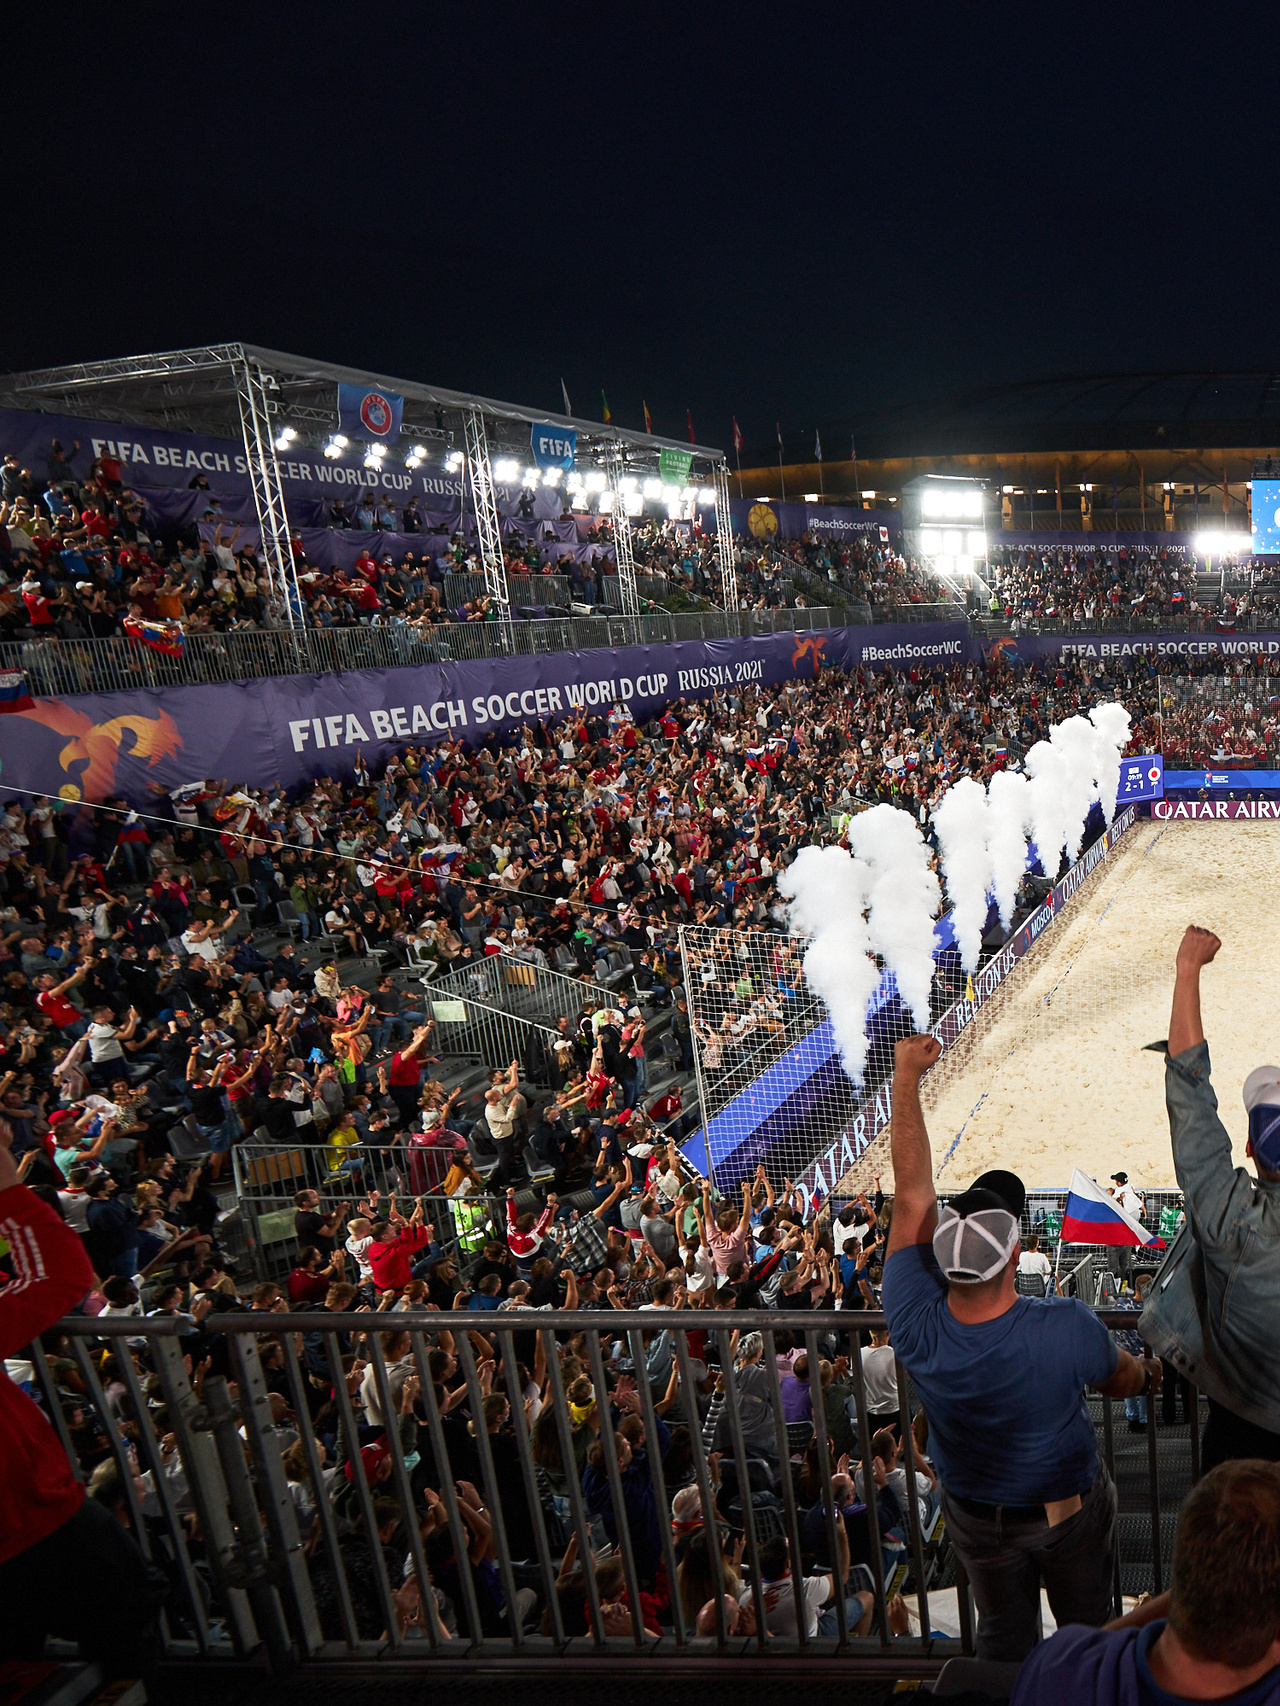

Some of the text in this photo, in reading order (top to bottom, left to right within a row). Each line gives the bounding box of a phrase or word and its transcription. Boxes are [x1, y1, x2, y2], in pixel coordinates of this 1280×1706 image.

[539, 437, 573, 458] FIFA
[91, 438, 150, 465] FIFA
[152, 445, 231, 473] BEACH
[315, 465, 378, 488] WORLD
[382, 473, 413, 491] CUP
[809, 518, 878, 531] #BeachSoccerWC
[1038, 544, 1073, 552] SOCCER
[1074, 544, 1107, 553] WORD
[862, 640, 962, 661] #BeachSoccerWC
[1061, 643, 1097, 657] FIFA
[1100, 643, 1153, 657] BEACH
[1157, 642, 1218, 655] SOCCER
[1221, 641, 1279, 655] WORLD
[289, 712, 370, 752] FIFA
[369, 699, 468, 740] BEACH
[472, 686, 561, 724] SOCCER
[564, 677, 634, 708] WORLD
[636, 672, 669, 697] CUP
[678, 665, 733, 691] RUSSIA
[1154, 801, 1230, 820] QATAR
[1062, 837, 1107, 902] QATAR AIRWAY
[985, 960, 1001, 996] ON
[1002, 943, 1016, 975] US
[789, 1113, 870, 1226] QATAR
